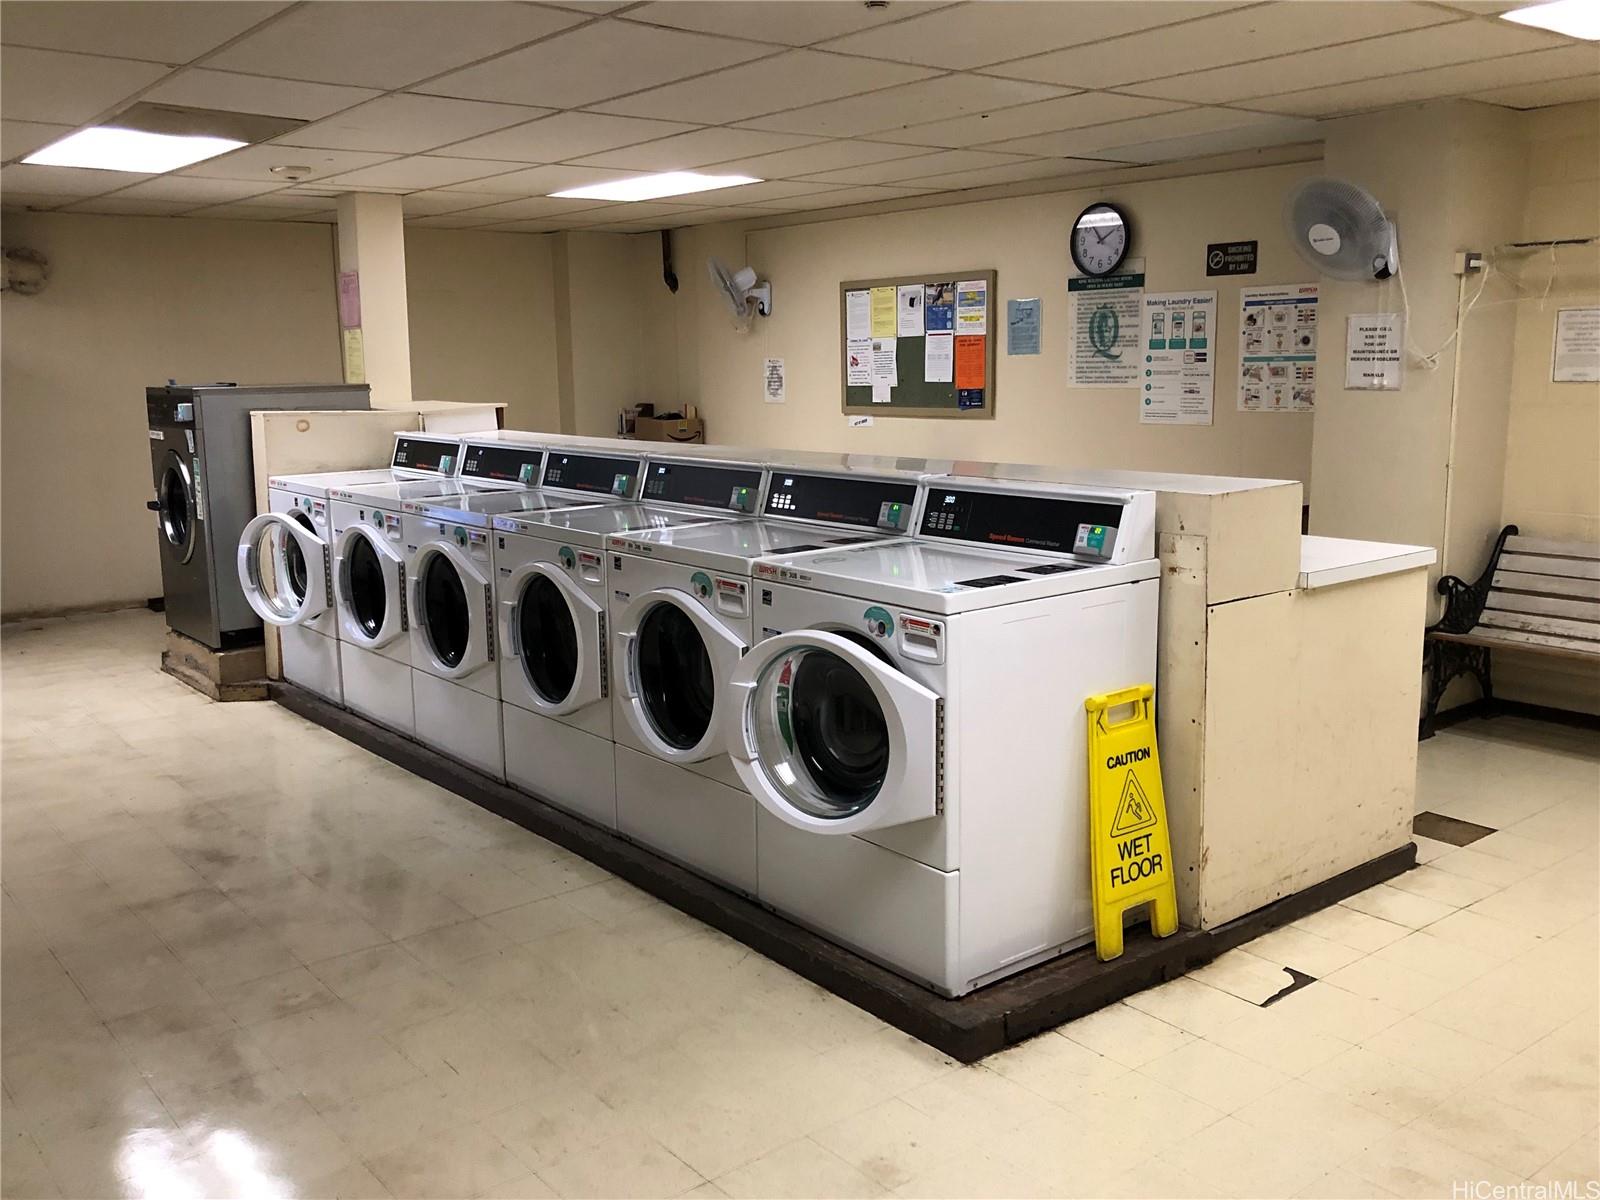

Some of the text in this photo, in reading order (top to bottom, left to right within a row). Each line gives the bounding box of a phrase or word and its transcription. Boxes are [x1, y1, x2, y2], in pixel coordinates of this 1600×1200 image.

[1080, 236, 1086, 246] 9
[1118, 234, 1124, 245] 3
[1082, 248, 1088, 258] 8
[1113, 248, 1119, 257] 4
[1088, 256, 1095, 266] 7
[1106, 256, 1113, 266] 5
[1224, 253, 1255, 263] PROHIBITED
[1097, 259, 1103, 269] 6
[1229, 263, 1249, 271] BY LAW
[1146, 299, 1166, 307] Making
[1167, 298, 1191, 306] Laundry
[1106, 746, 1151, 769] CAUTION
[1118, 833, 1153, 862] WET
[1110, 853, 1163, 888] FLOOR
